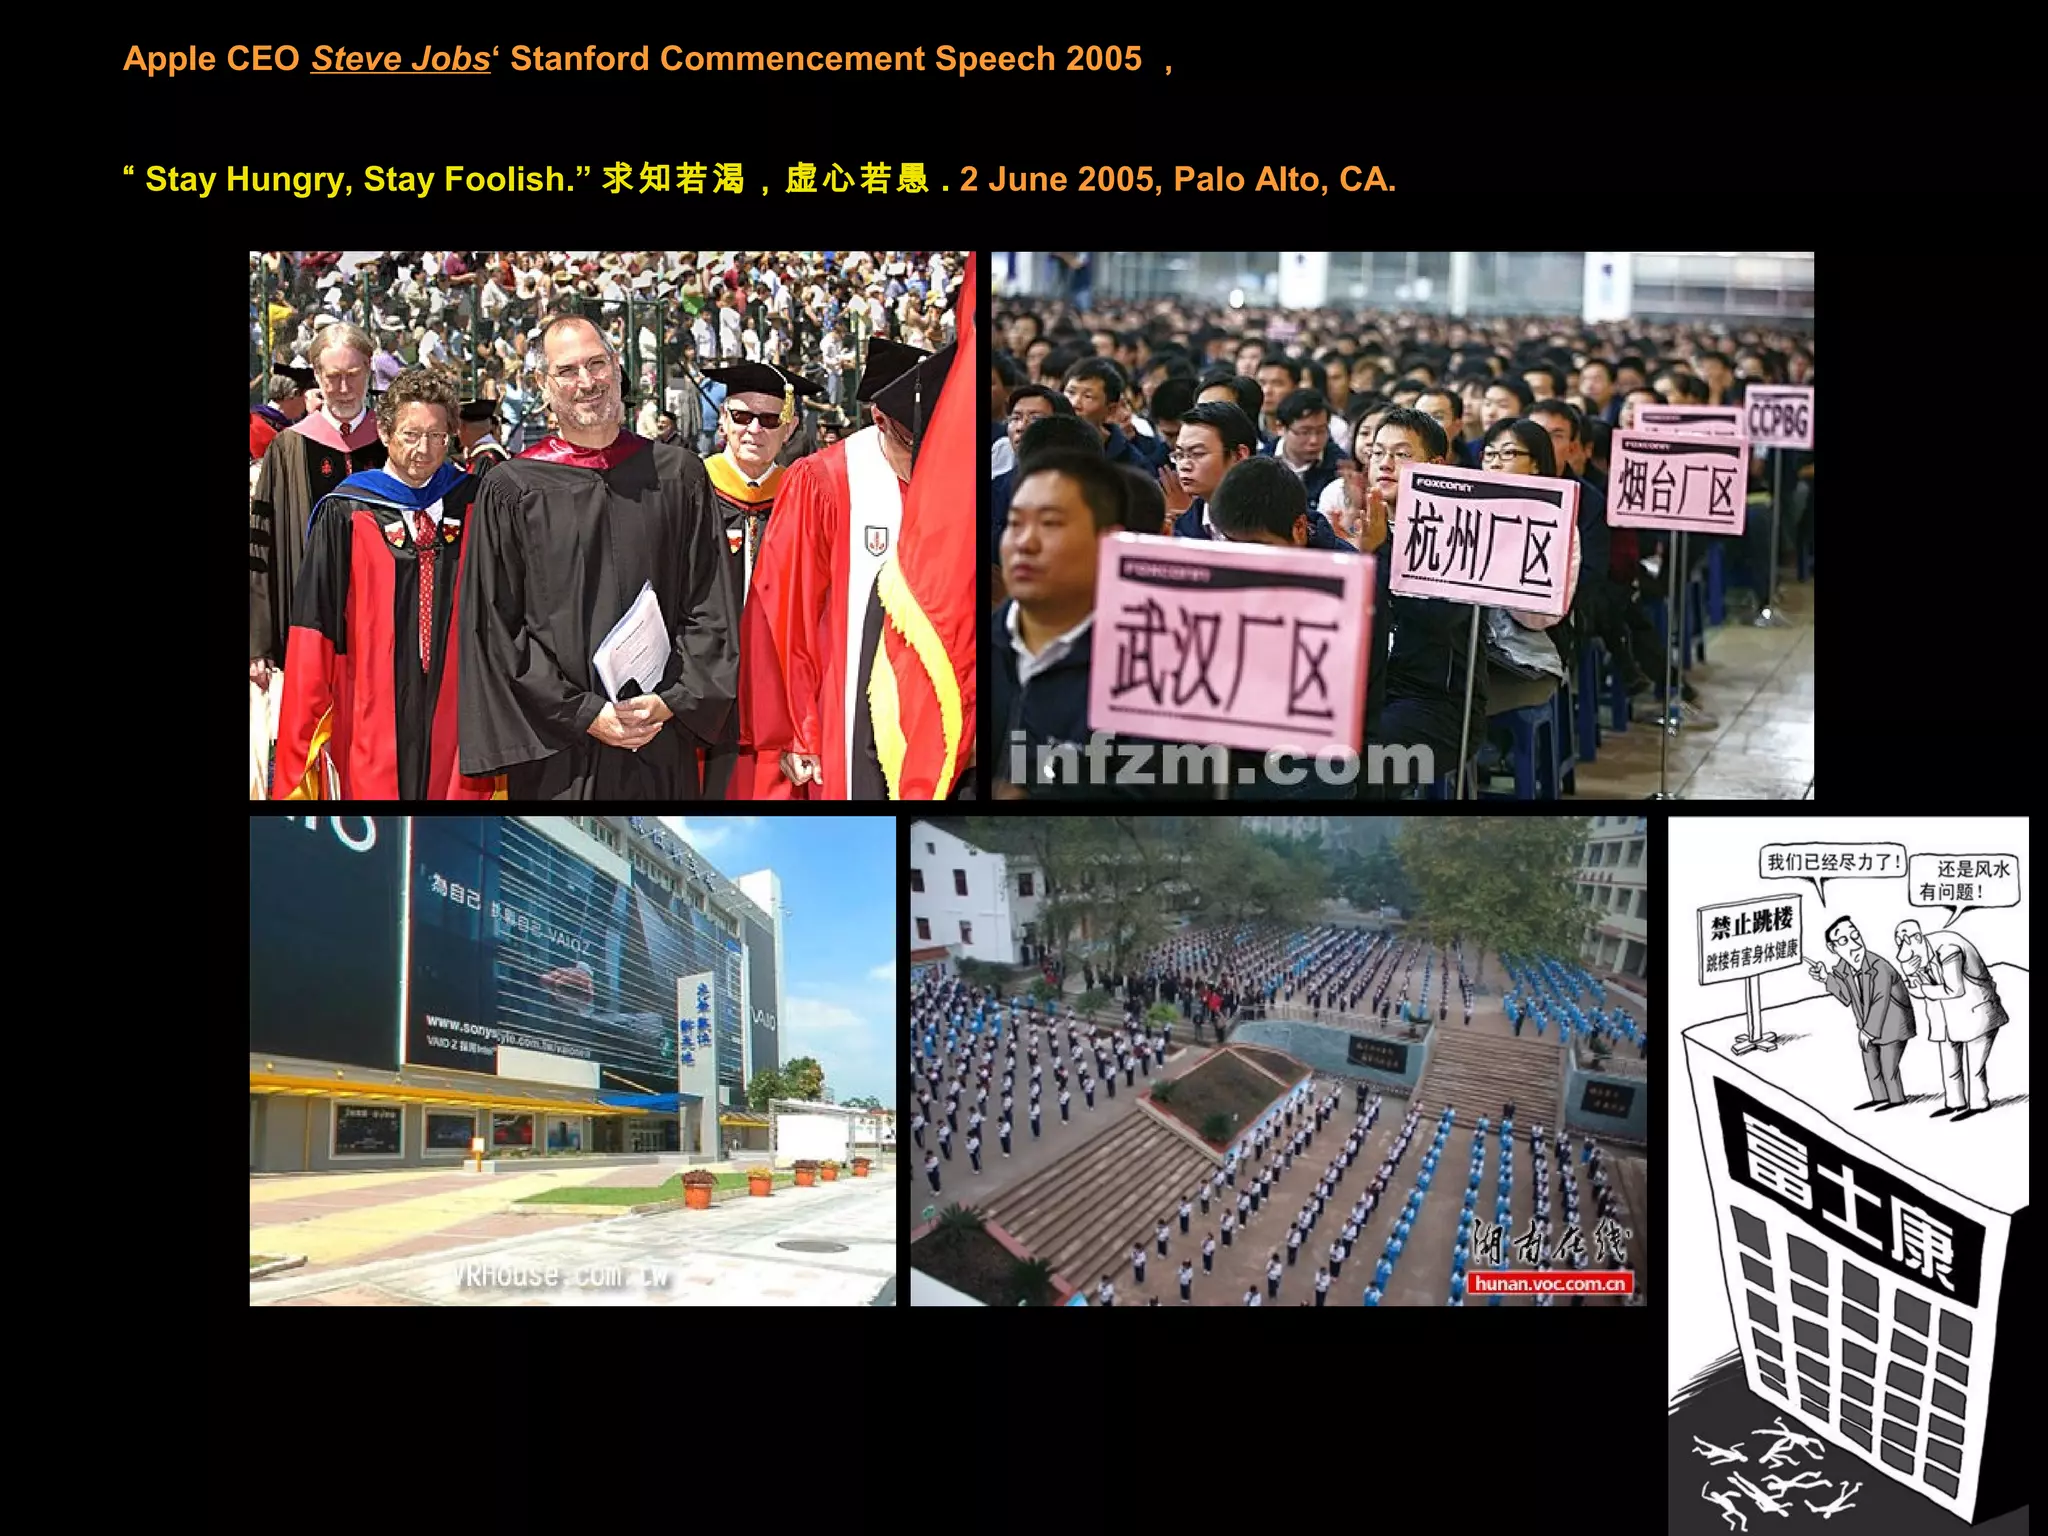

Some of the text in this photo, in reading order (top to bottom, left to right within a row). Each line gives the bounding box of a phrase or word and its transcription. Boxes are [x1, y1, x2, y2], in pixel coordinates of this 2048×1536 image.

[1749, 402, 1809, 438] CCPBG
[1417, 477, 1474, 493] FOXCONN
[1617, 457, 1738, 516] 烟台厂区
[1404, 499, 1558, 588] 杭州厂区
[1110, 598, 1339, 721] 武汉厂区
[1938, 860, 2010, 878] 还是风水
[1711, 905, 1794, 941] 禁止跳楼
[1706, 938, 1799, 972] 跳楼有害身体健康
[1743, 1111, 1955, 1292] 富士康
